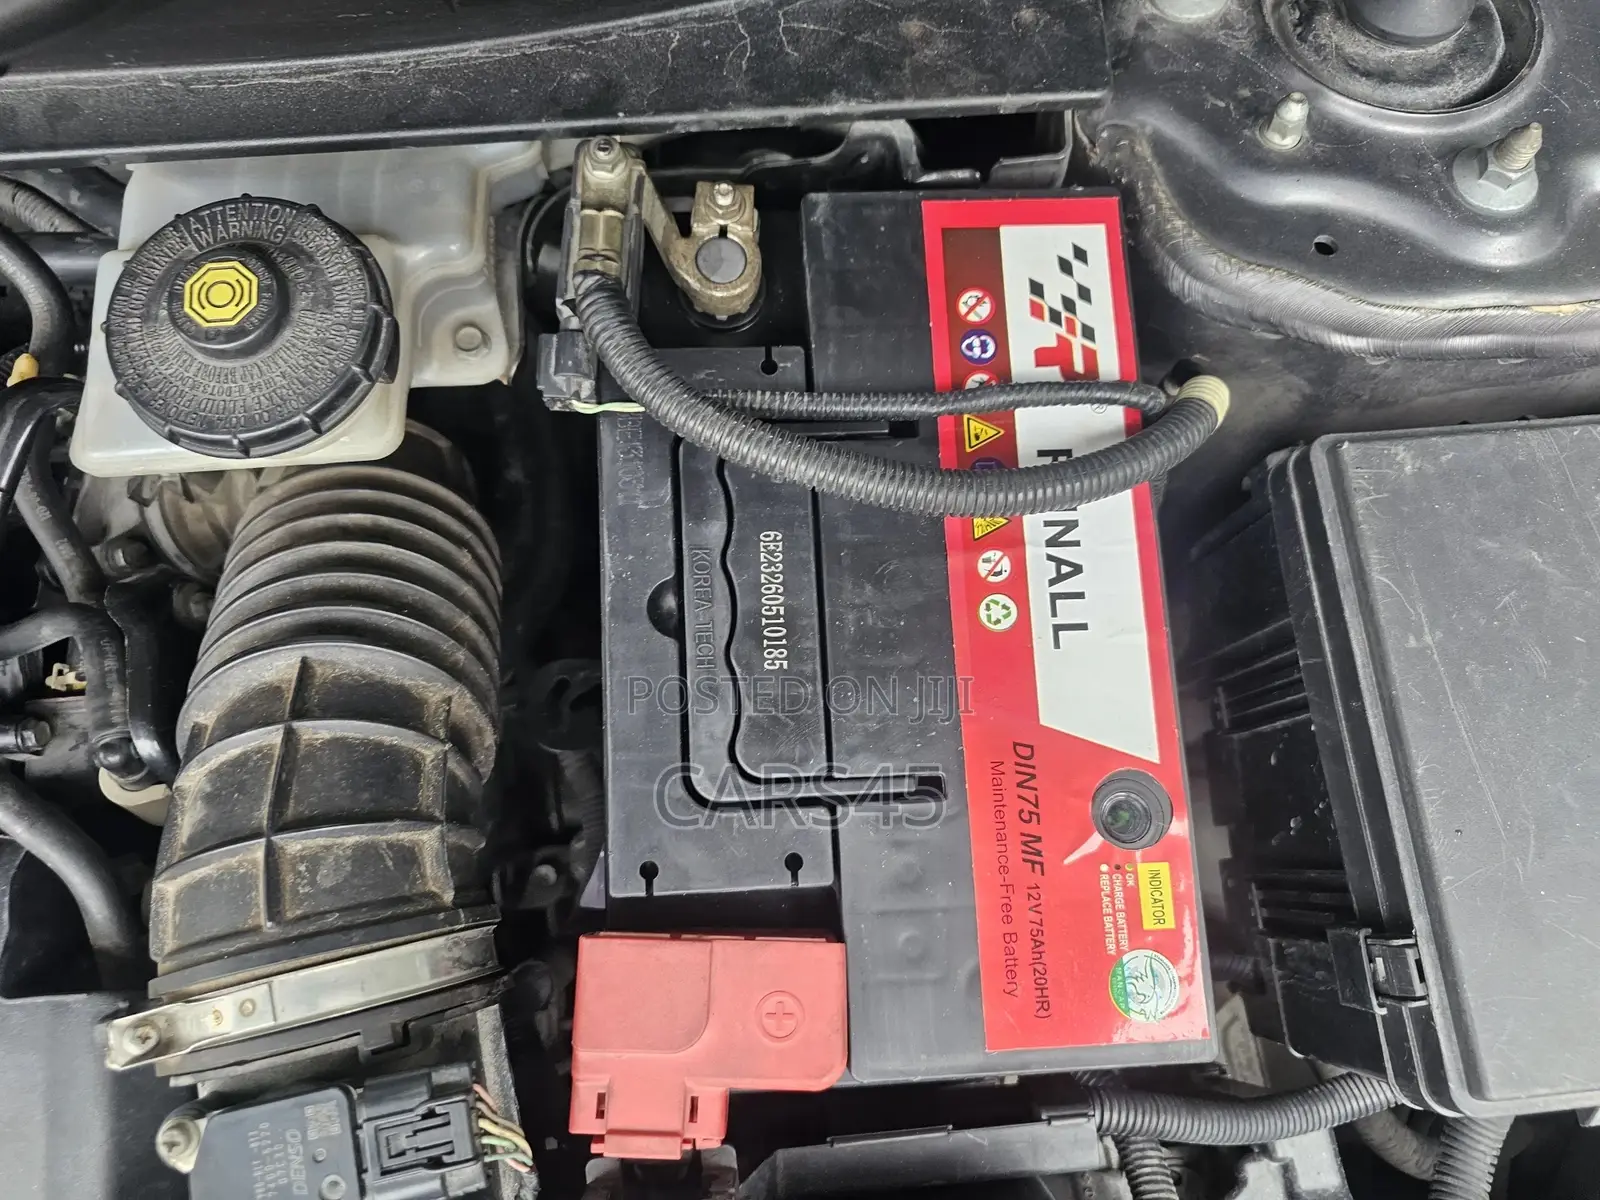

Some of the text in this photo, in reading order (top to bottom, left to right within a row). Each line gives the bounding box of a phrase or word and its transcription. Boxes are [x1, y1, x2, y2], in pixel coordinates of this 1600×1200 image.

[188, 202, 297, 234] ATTENTION
[194, 222, 287, 247] WARNING
[328, 324, 348, 342] OR
[193, 360, 237, 384] BEFORE
[239, 362, 263, 382] CAP
[152, 376, 196, 409] FROM
[198, 398, 247, 412] FLUID
[250, 377, 306, 410] BRAKE
[690, 549, 716, 669] KOREA TECH
[760, 530, 788, 671] 6E23260510185
[1012, 741, 1041, 825] DIN75
[1020, 832, 1045, 876] MF
[990, 761, 1018, 998] Maintenance-Free Battery
[1125, 872, 1135, 887] OK
[1147, 869, 1166, 925] INDICATOR
[1100, 874, 1117, 956] REPLACE BATTERY
[1112, 873, 1129, 951] CHARGE BATTERY
[286, 1128, 309, 1196] DENSO
